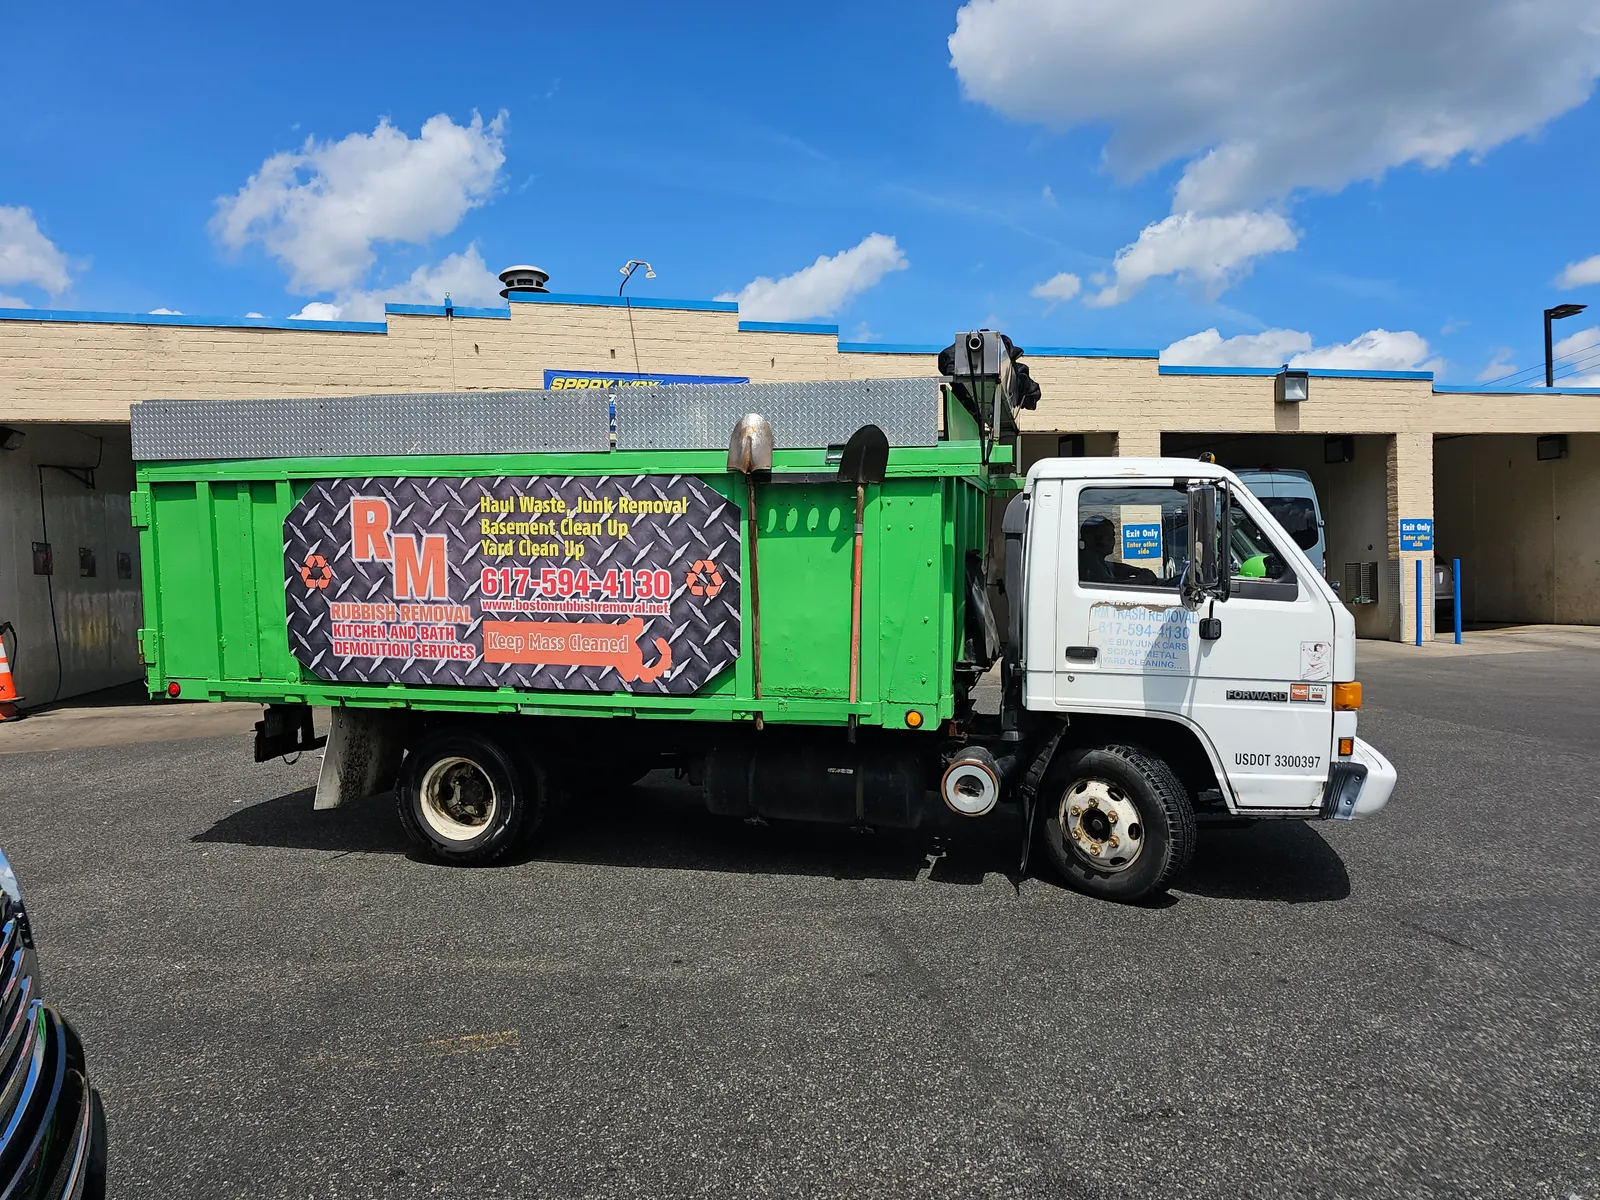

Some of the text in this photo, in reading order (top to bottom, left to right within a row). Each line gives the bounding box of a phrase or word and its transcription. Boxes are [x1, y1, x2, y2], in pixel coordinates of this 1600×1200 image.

[551, 378, 614, 390] SPRAY
[480, 496, 687, 517] Haul Waste, Junk Removal
[481, 519, 629, 540] Basement Clean Up
[1126, 529, 1158, 539] Exit Only
[1403, 523, 1430, 532] Exit Only
[481, 540, 585, 560] Yard Clean Up
[480, 567, 672, 598] 617-594-4130
[331, 603, 472, 623] RUBBISH REMOVAL
[481, 598, 671, 615] www.bostonrubbishremoval.net
[1094, 606, 1197, 624] RM TRASH REMOVAL
[333, 624, 455, 641] KITCHEN AND BATH
[1098, 622, 1190, 640] 617-594-4130
[333, 641, 475, 659] DEMOLITION SERVICES
[488, 632, 629, 653] Keep Mass Cleaned
[1117, 639, 1134, 647] BUY
[1136, 640, 1160, 649] JUNK
[1162, 641, 1187, 650] CARS
[1103, 657, 1126, 665] YARD
[1108, 647, 1178, 659] SCRAP METAL
[1227, 690, 1287, 700] FORWARD
[1235, 753, 1321, 768] USDOT 3300397
